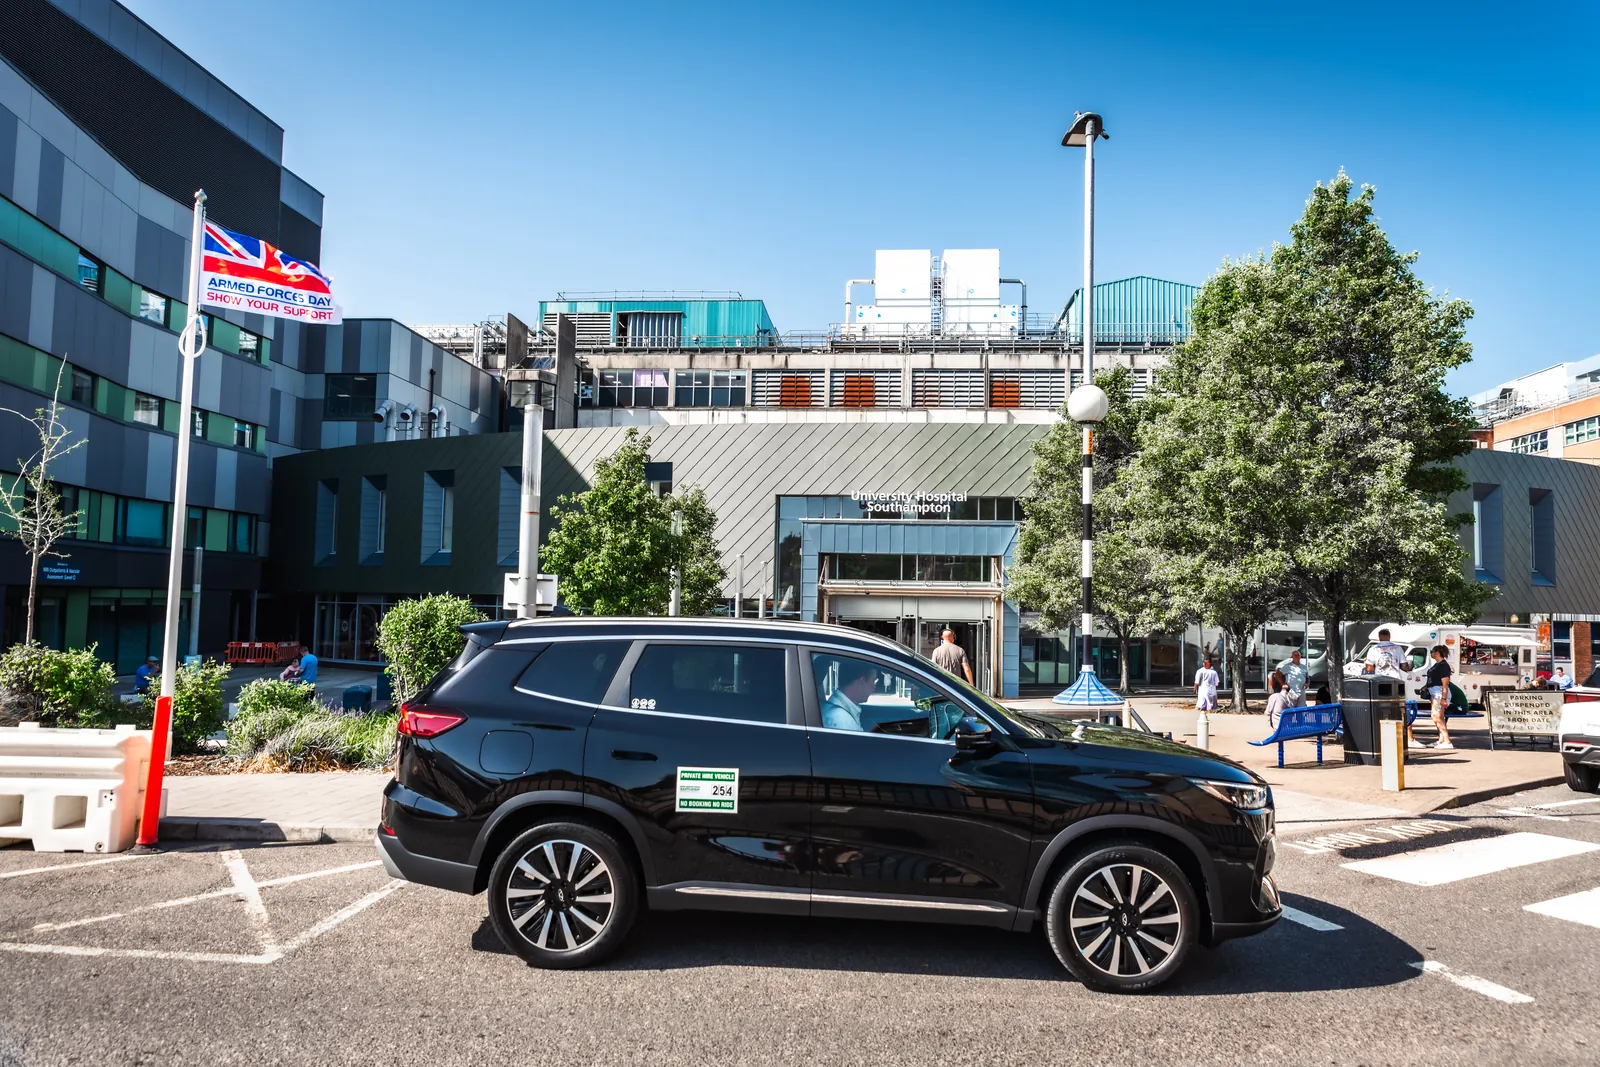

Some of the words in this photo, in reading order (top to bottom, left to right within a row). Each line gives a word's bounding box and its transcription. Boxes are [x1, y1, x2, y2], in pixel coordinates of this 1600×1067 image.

[208, 278, 254, 293] ARMED
[257, 285, 305, 302] FORCES
[308, 295, 331, 306] DAY
[207, 291, 242, 306] SHOW
[246, 298, 279, 312] YOUR
[851, 490, 913, 503] University
[915, 491, 968, 504] Hospital
[867, 501, 951, 515] Southampton
[712, 785, 732, 796] 254
